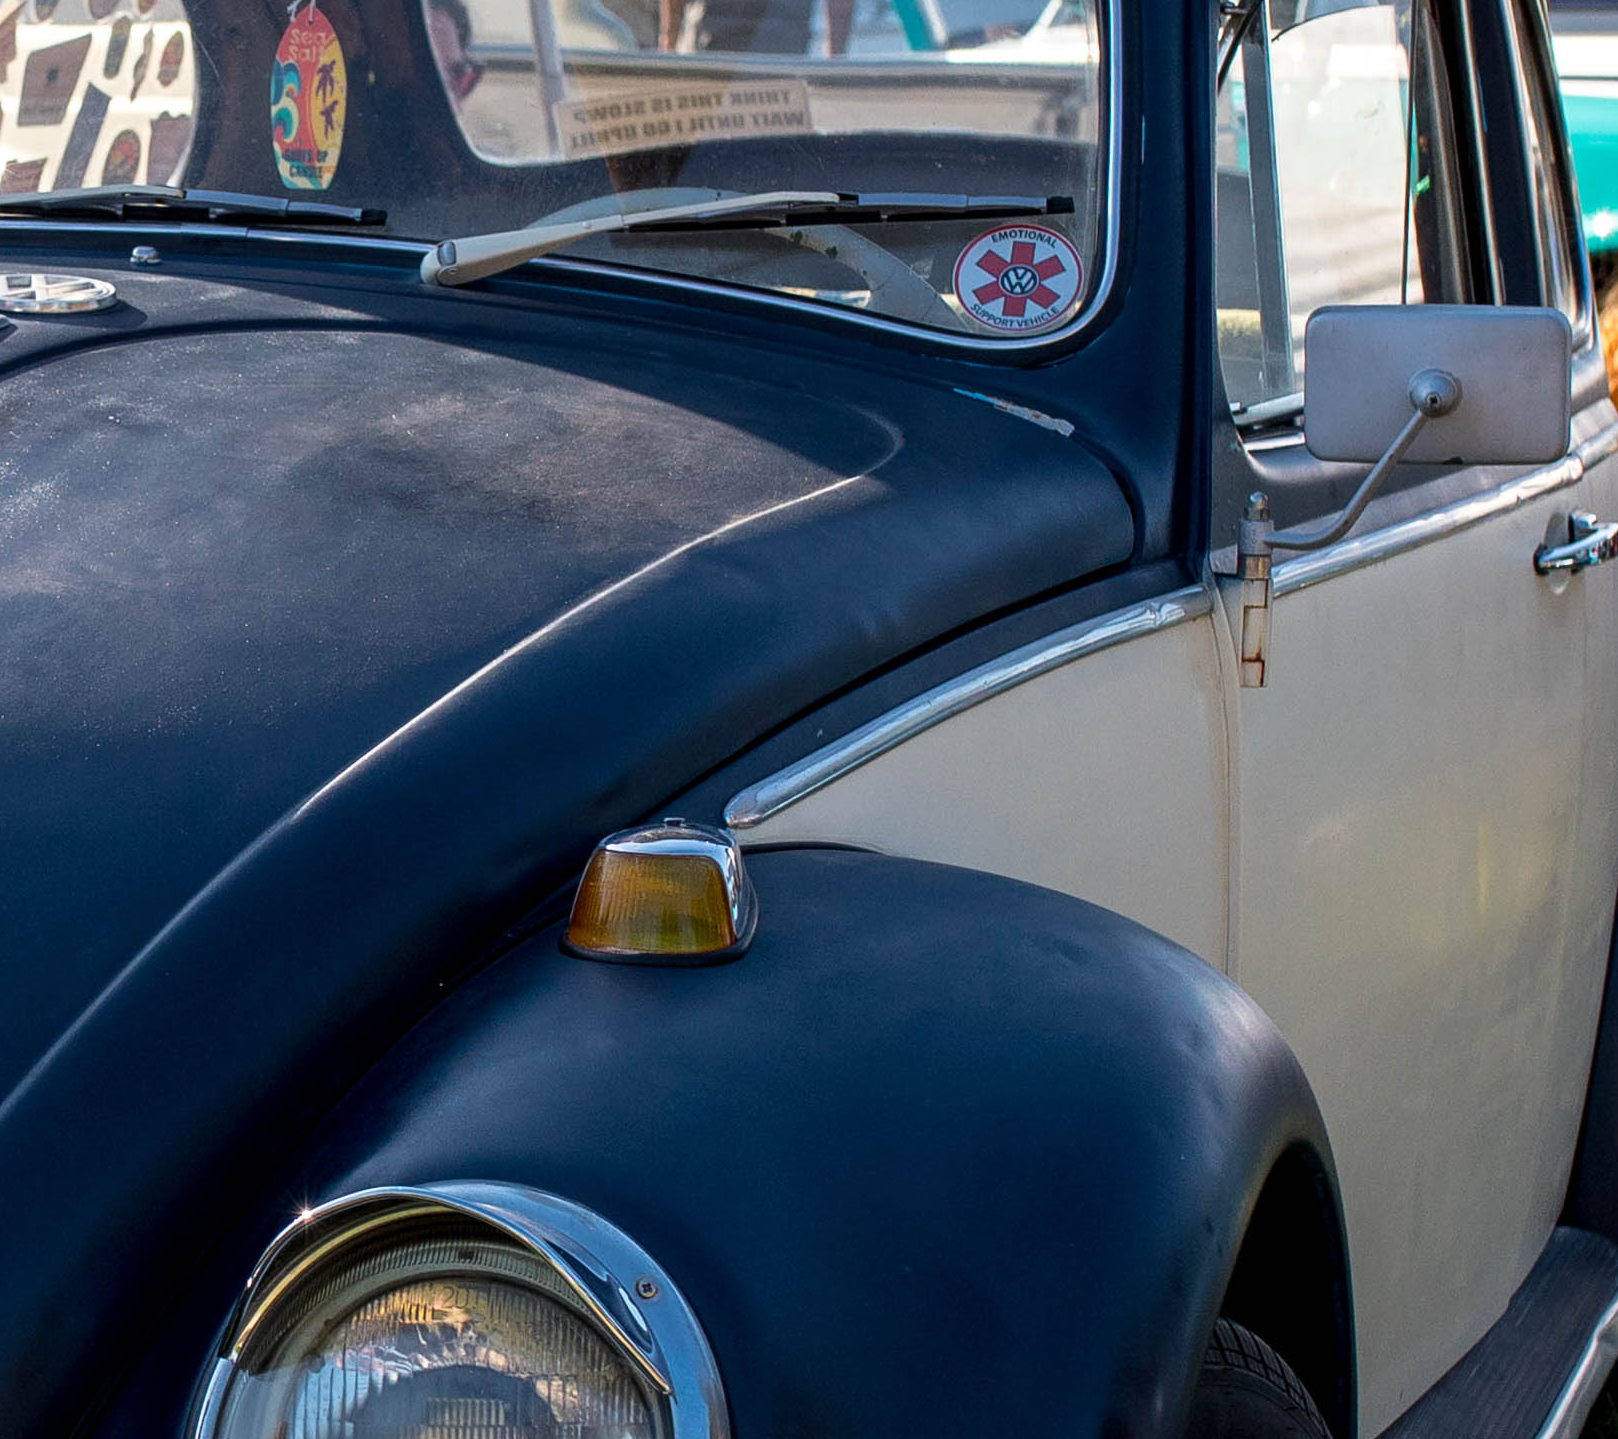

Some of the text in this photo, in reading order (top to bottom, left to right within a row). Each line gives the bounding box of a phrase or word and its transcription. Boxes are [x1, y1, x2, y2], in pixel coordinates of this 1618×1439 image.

[290, 28, 327, 45] Sea
[991, 229, 1058, 249] EMOTIONAL
[970, 303, 1060, 328] SUPPORT VEHICLE
